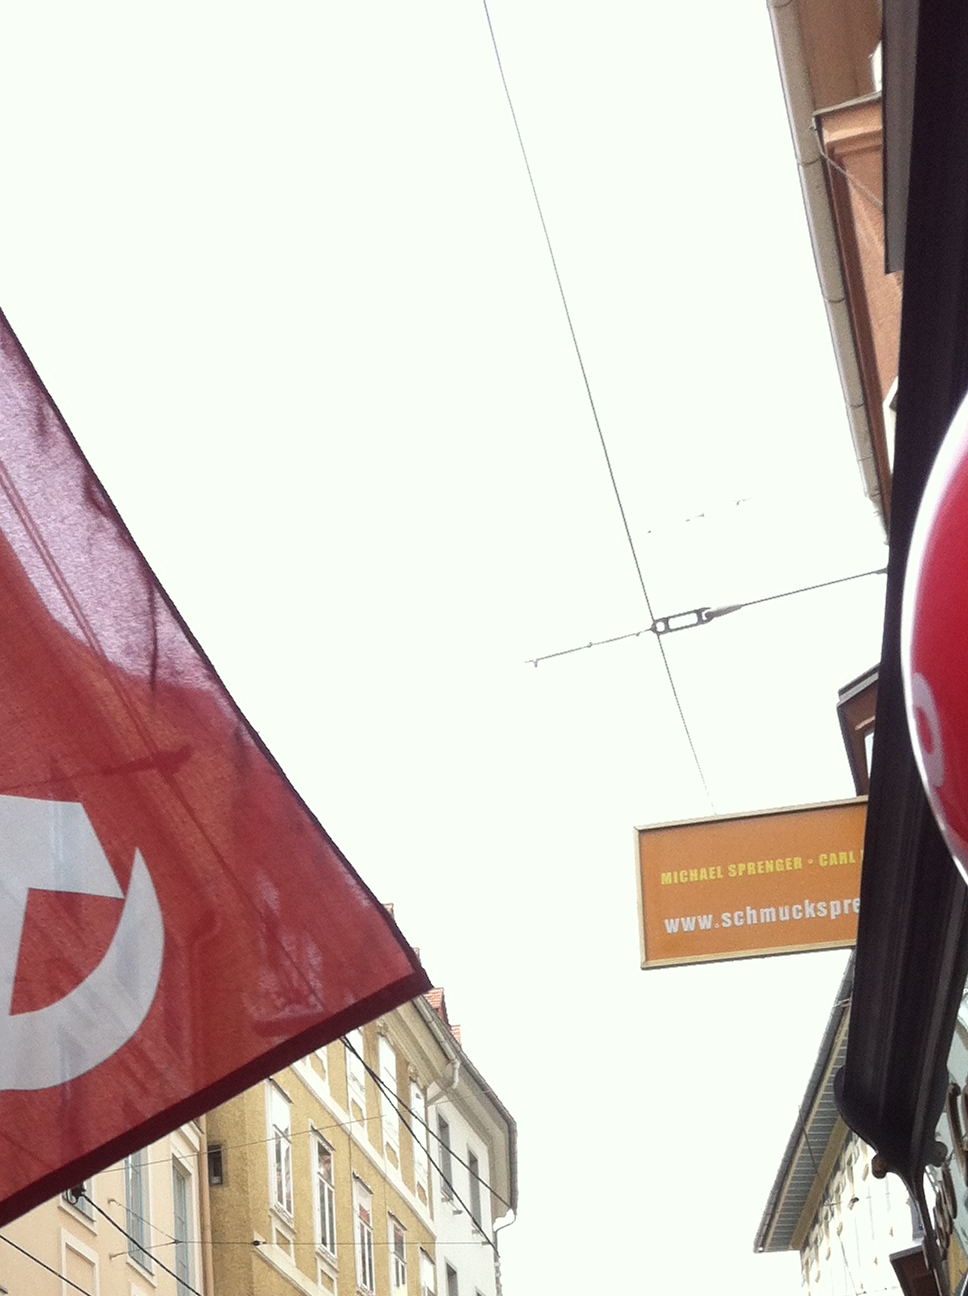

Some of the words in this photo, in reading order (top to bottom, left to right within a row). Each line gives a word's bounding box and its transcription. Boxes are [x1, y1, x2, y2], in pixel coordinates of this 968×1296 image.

[660, 864, 724, 886] MICHAEL
[728, 856, 803, 878] SPRENGER
[818, 850, 856, 867] CARL
